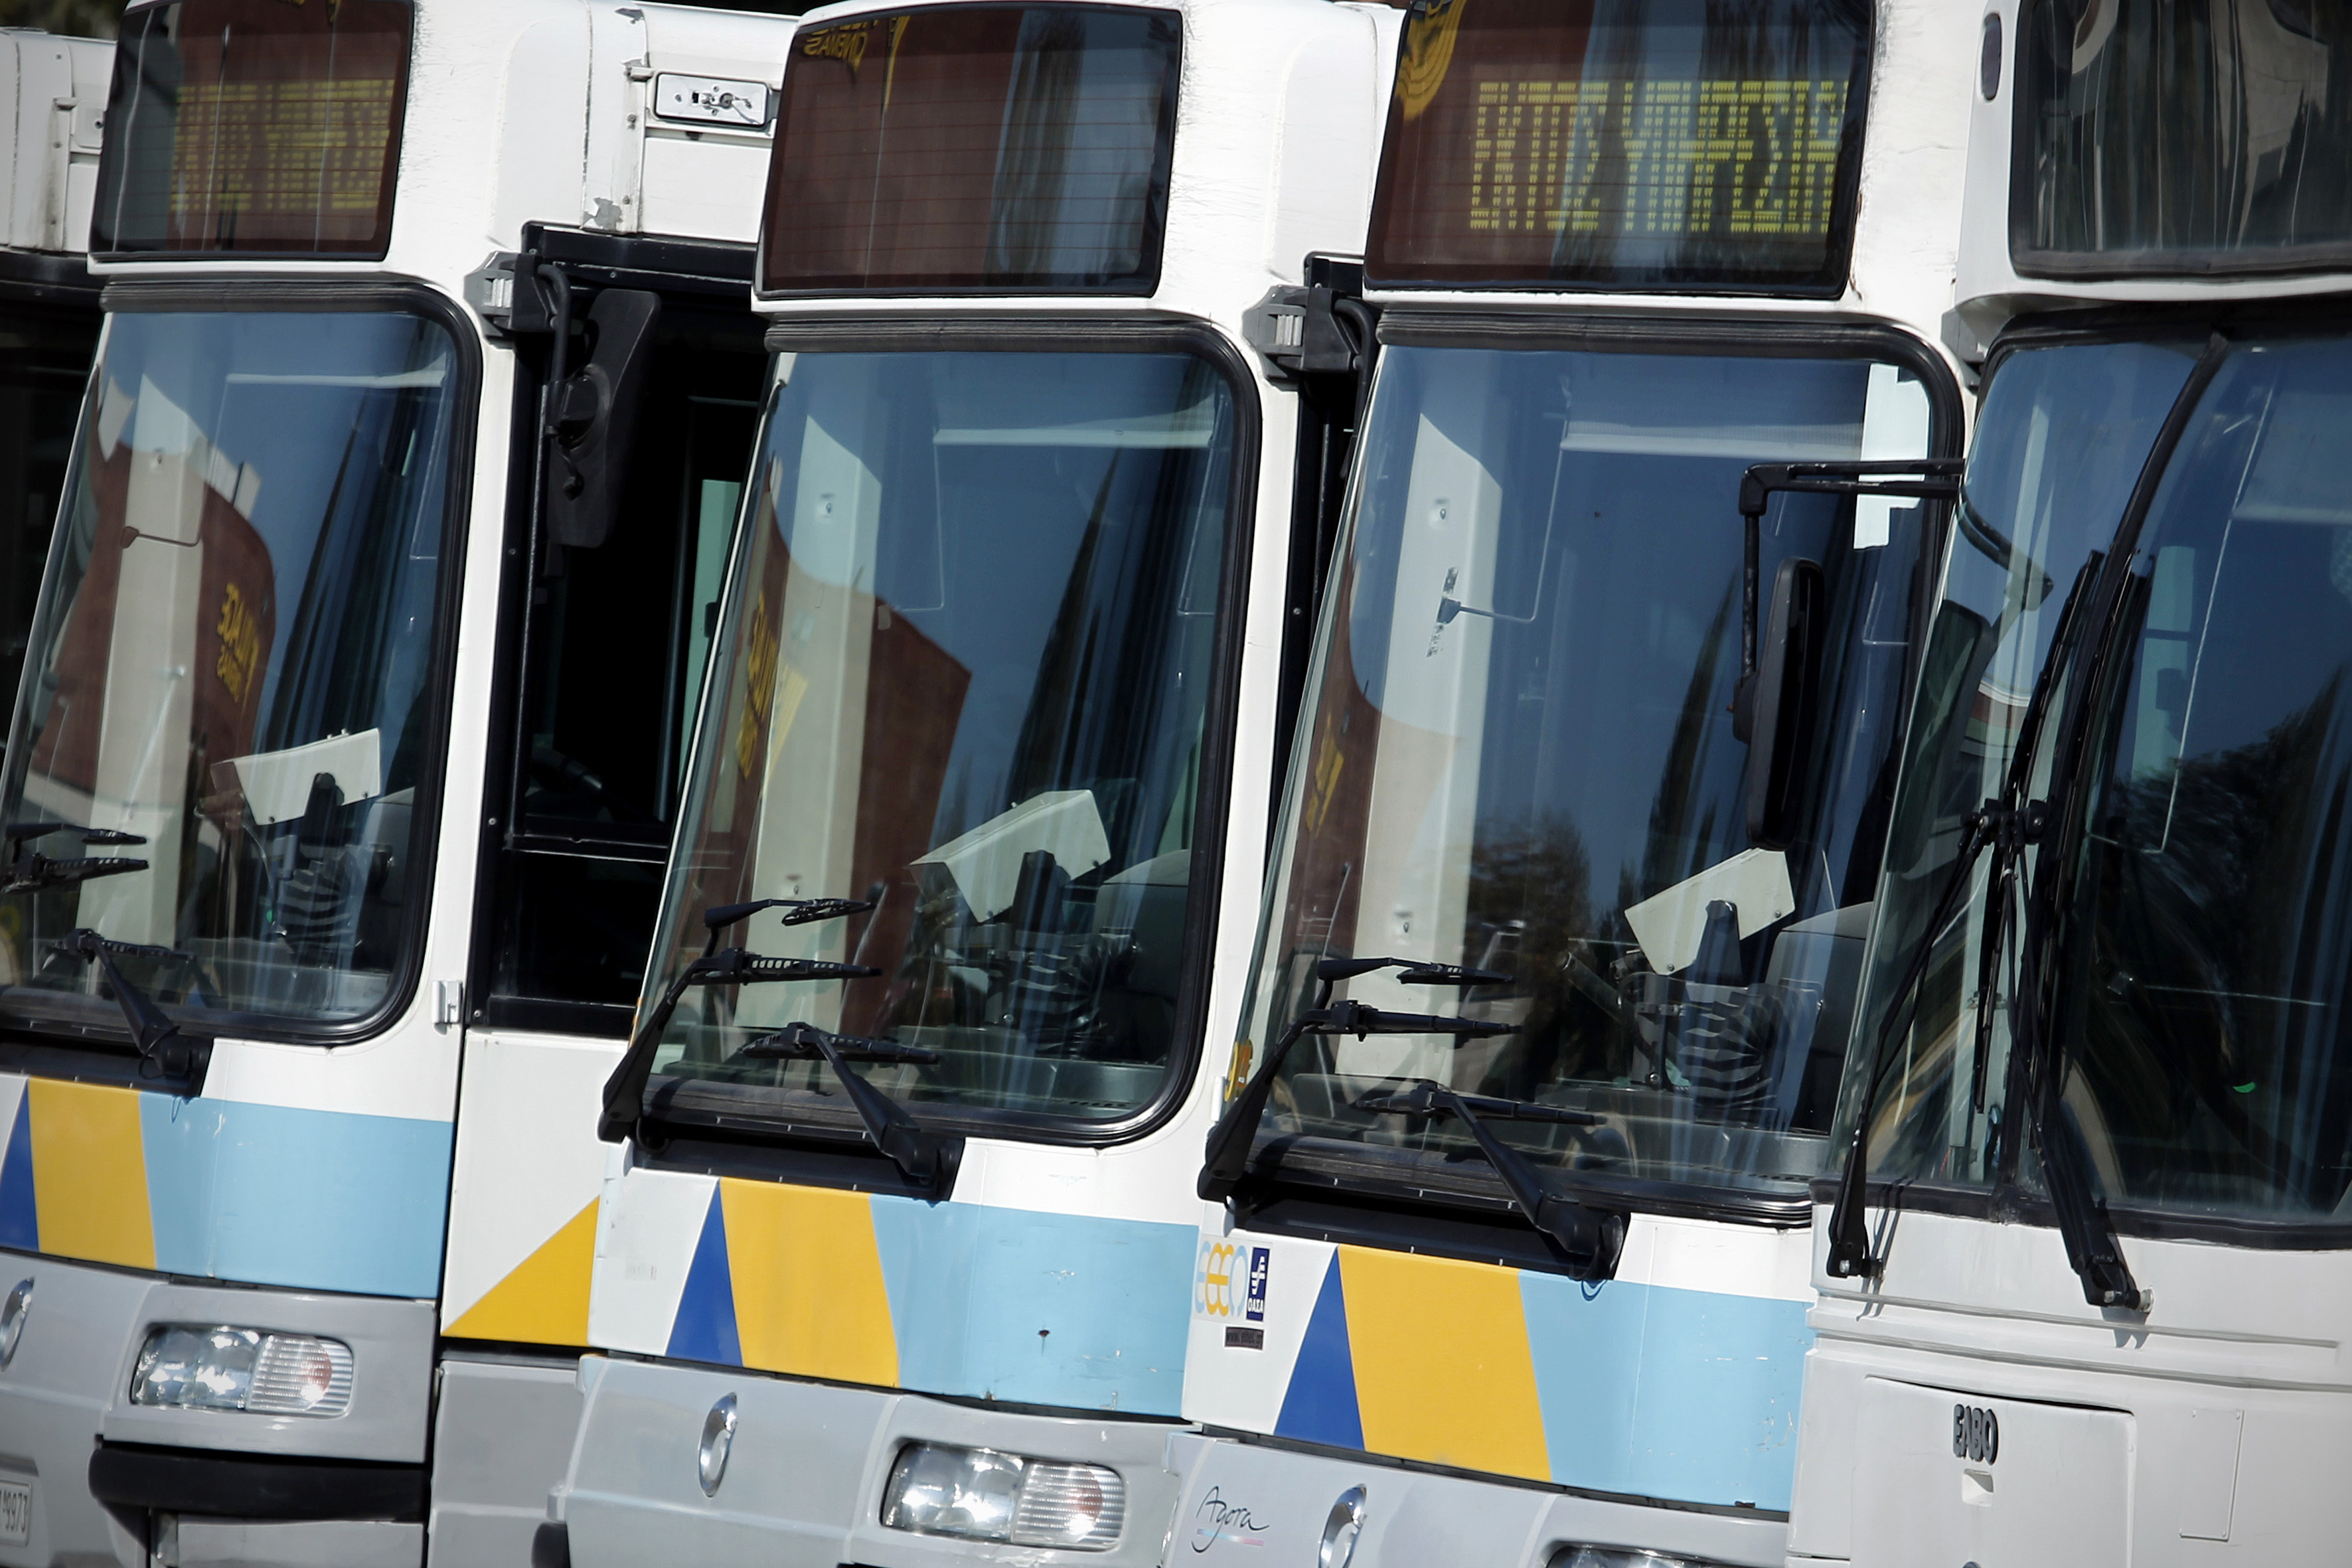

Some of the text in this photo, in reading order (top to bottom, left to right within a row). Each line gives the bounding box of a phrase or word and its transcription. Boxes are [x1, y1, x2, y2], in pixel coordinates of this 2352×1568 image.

[1470, 80, 1849, 234] ΕΚΤΟΣ ΥΠΗΡΕΣΙΑ
[1247, 1297, 1264, 1313] ΟΑΣΑ
[1191, 1485, 1270, 1553] Agora
